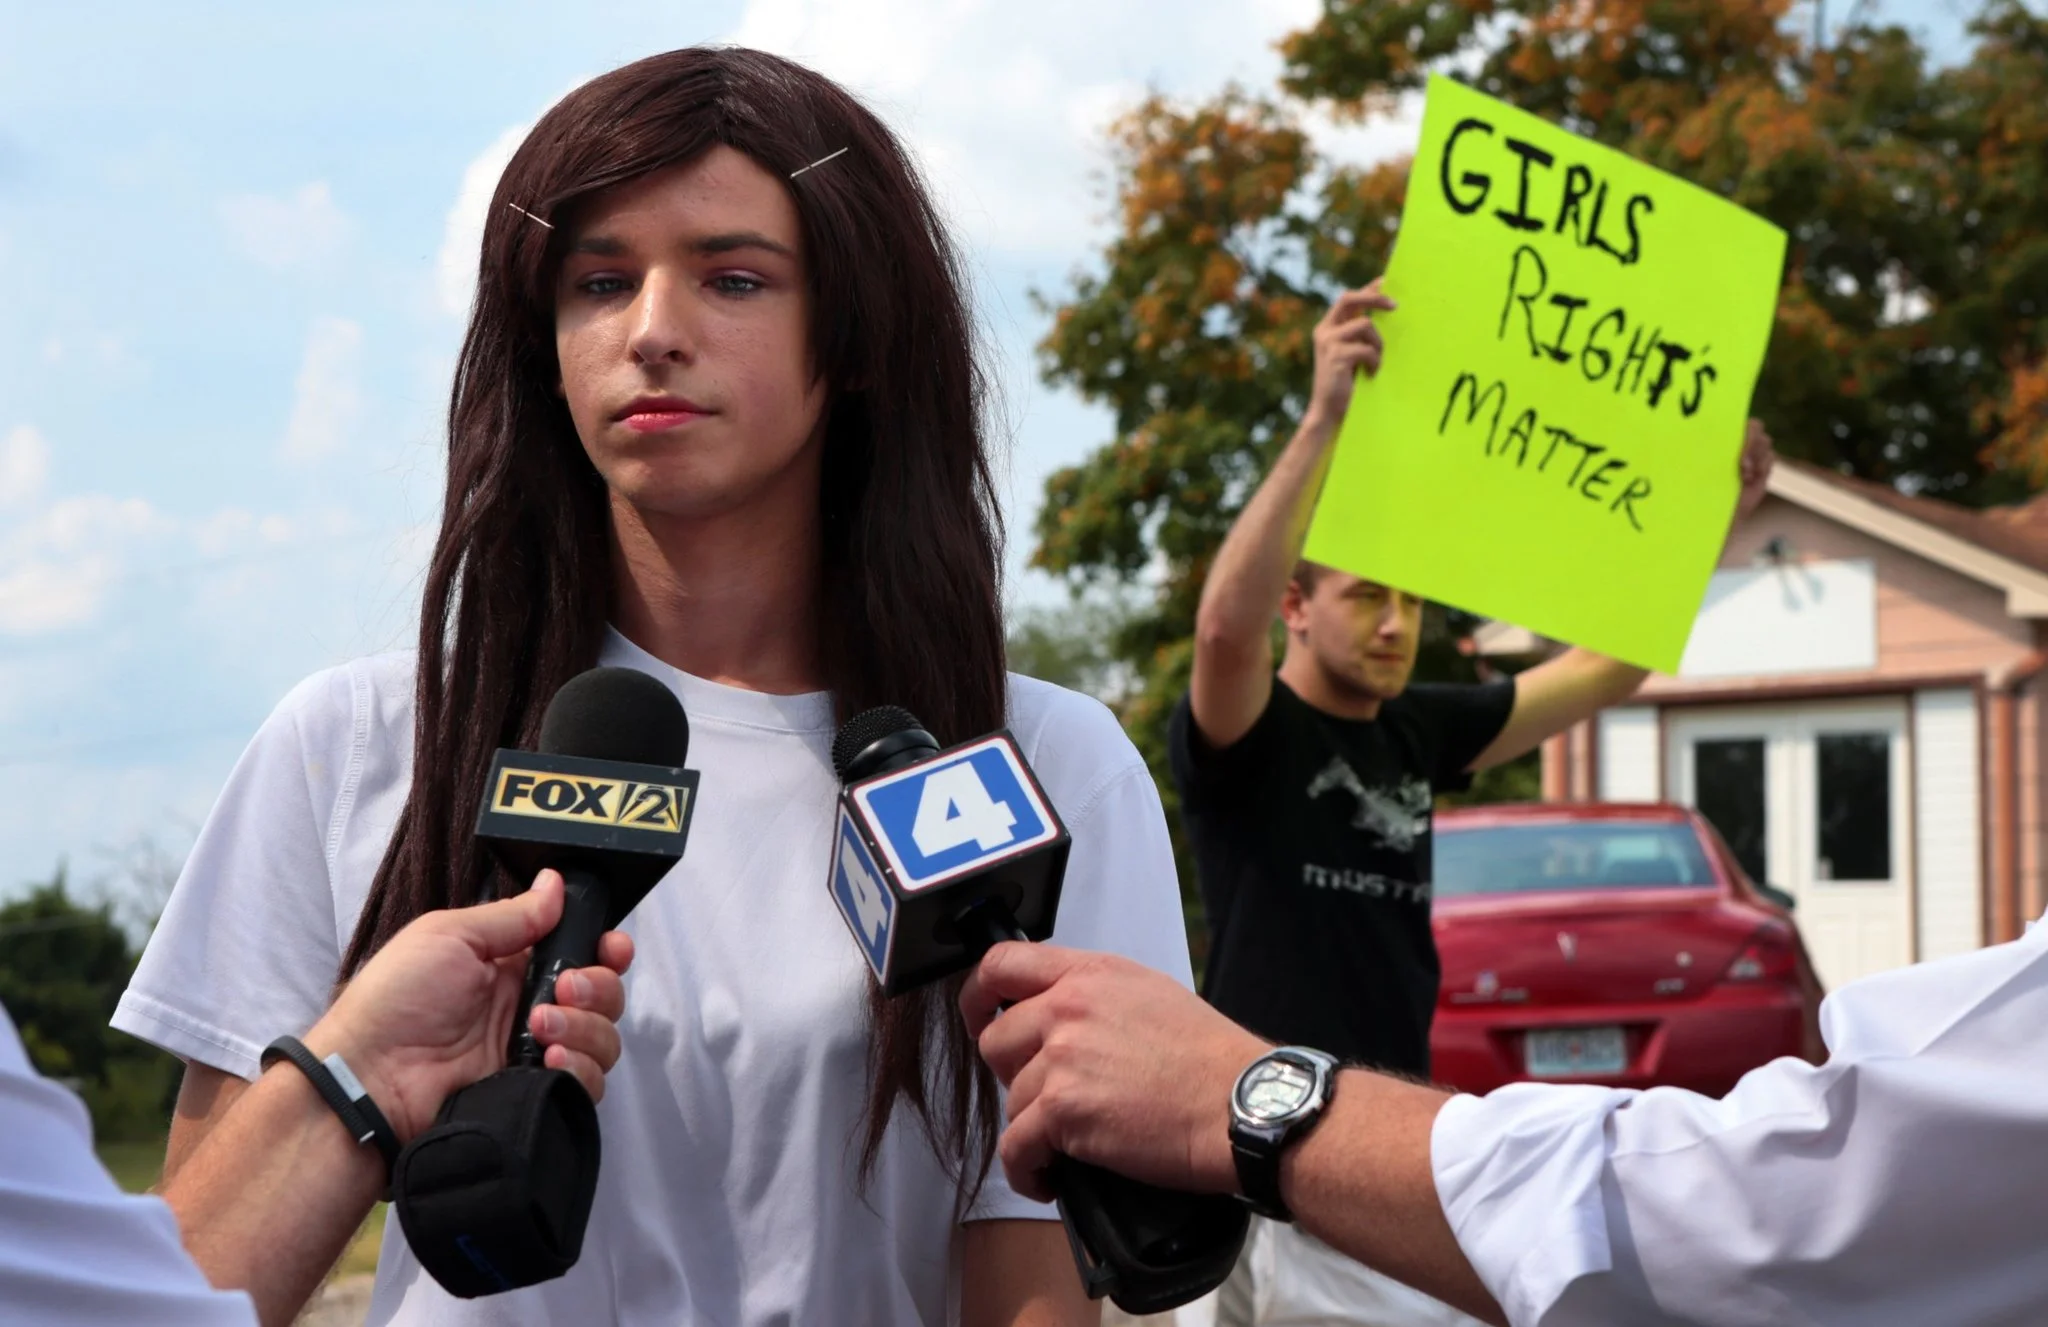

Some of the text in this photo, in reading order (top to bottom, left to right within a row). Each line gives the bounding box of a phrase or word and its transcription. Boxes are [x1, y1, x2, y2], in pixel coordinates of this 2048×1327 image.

[1440, 118, 1654, 265] GIRLS
[1439, 371, 1652, 531] MATTER
[499, 773, 614, 818] FOX
[911, 760, 1018, 858] 4
[840, 834, 889, 948] 4
